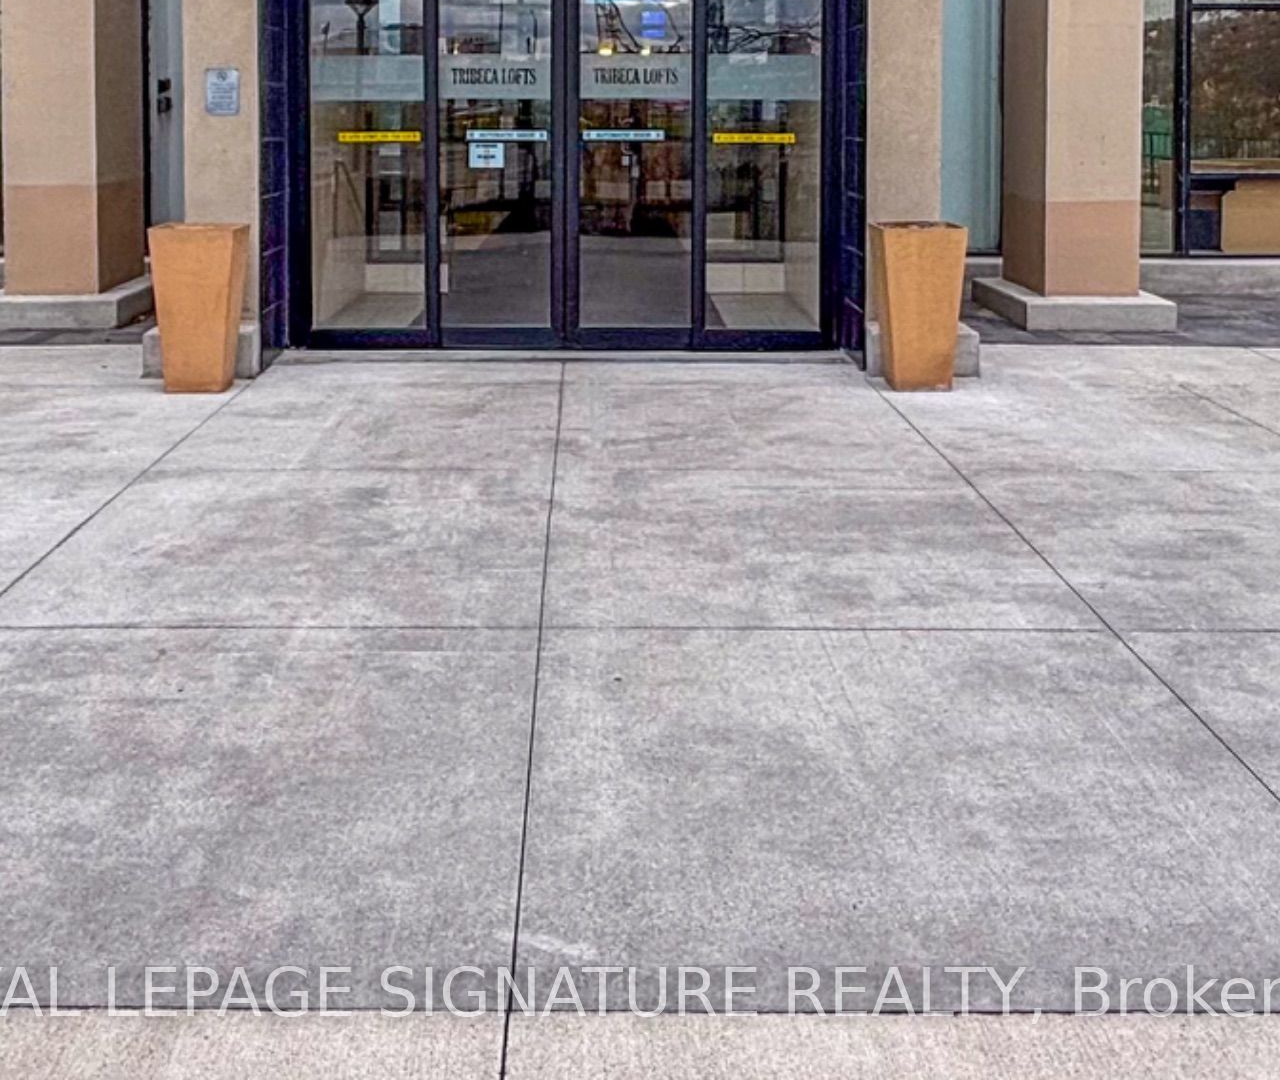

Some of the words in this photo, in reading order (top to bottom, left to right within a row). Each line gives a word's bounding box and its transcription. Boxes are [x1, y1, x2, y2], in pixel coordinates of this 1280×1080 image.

[451, 68, 498, 84] TRIBECA
[501, 68, 536, 84] LOFTS
[593, 68, 640, 84] TRIBECA
[643, 68, 678, 84] LOFTS
